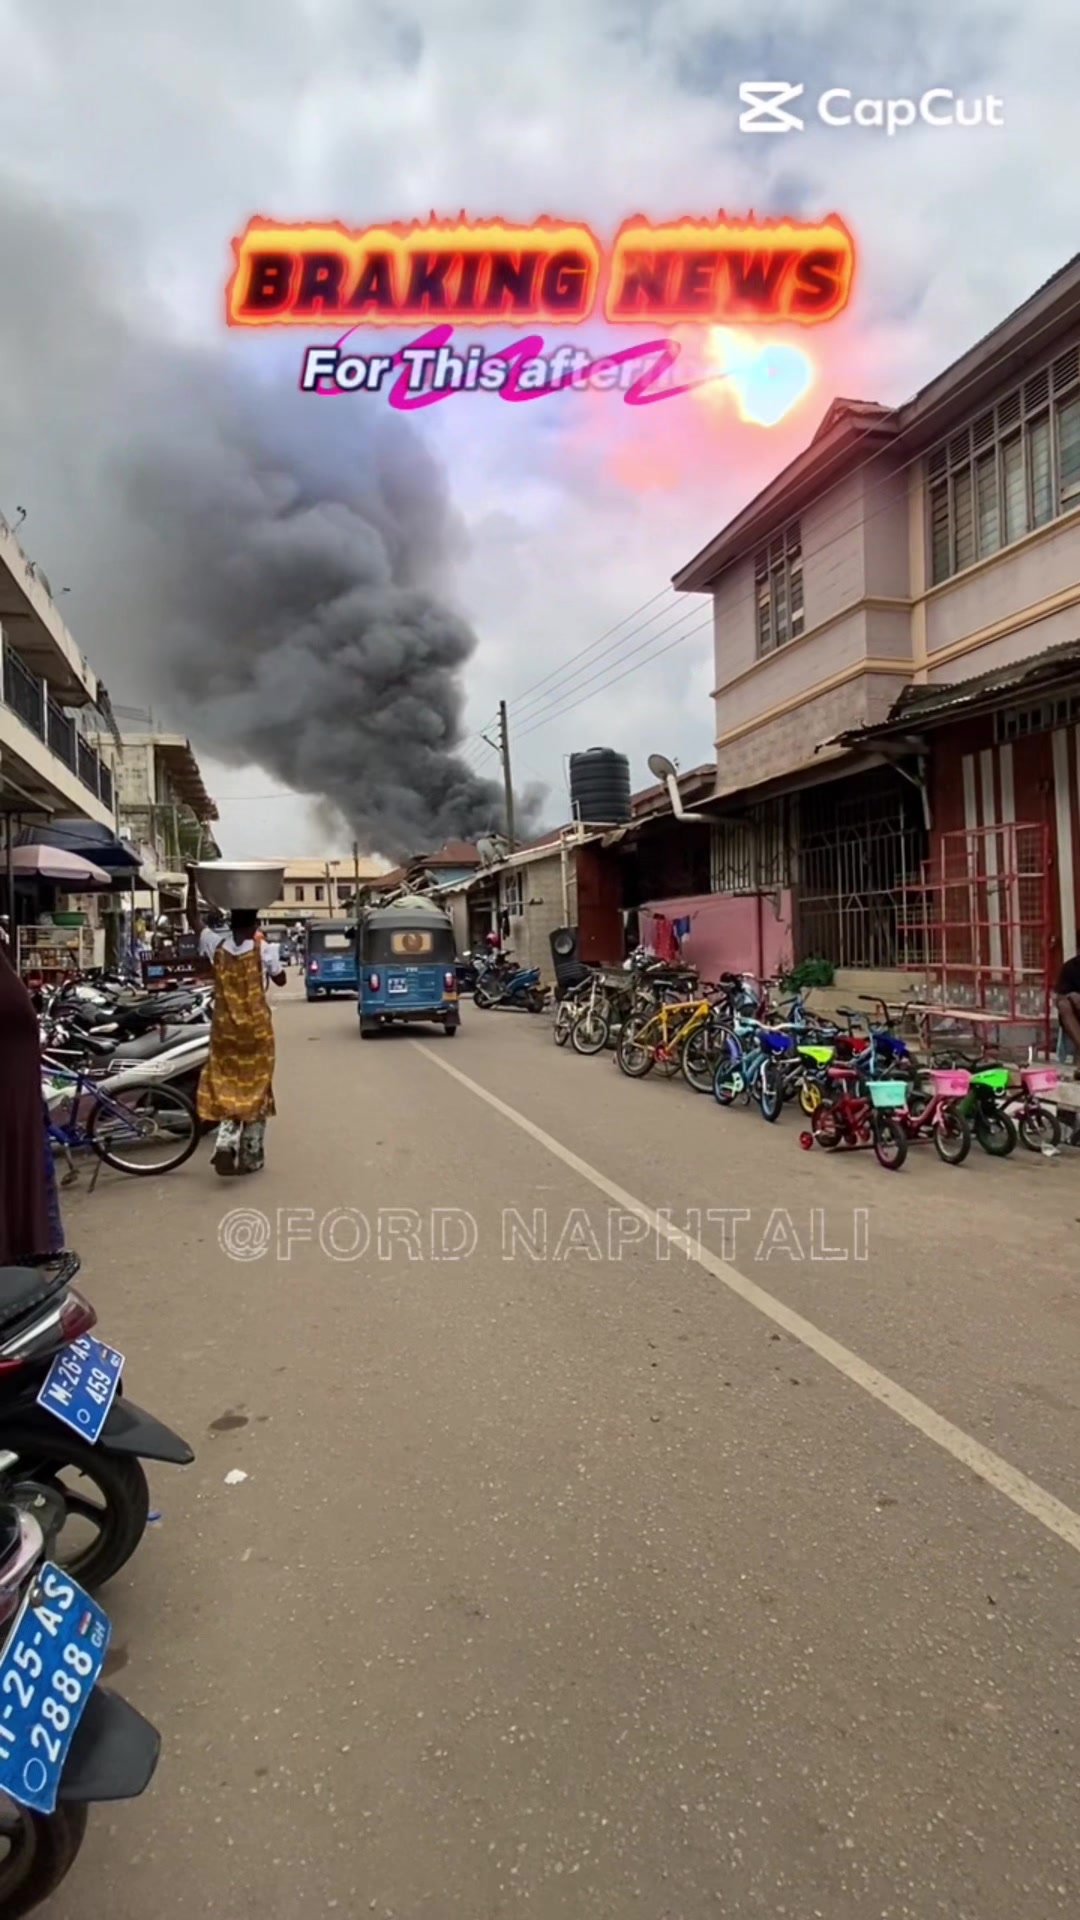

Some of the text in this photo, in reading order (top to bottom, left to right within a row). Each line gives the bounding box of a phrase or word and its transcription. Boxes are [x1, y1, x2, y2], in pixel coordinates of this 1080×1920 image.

[84, 1367, 112, 1405] 459
[91, 1621, 106, 1648] GH
[31, 1642, 93, 1763] 2888
